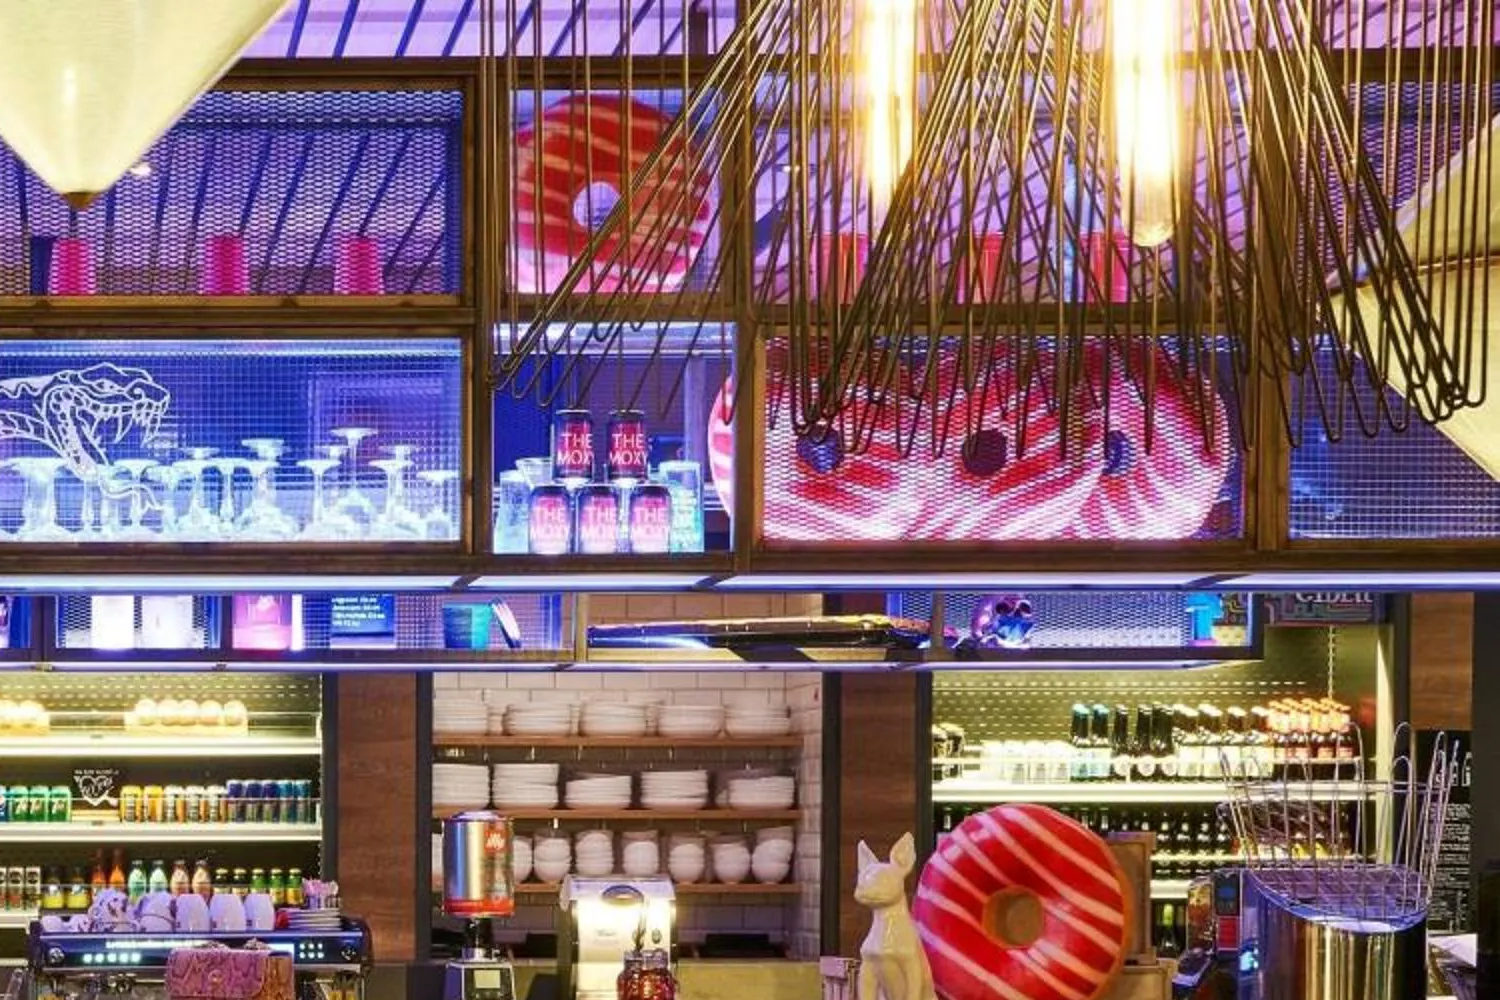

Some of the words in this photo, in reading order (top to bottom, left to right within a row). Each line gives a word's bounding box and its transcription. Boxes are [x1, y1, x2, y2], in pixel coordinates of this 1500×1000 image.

[561, 433, 593, 449] THE
[611, 433, 645, 449] THE
[534, 506, 566, 523] THE
[633, 507, 666, 523] THE
